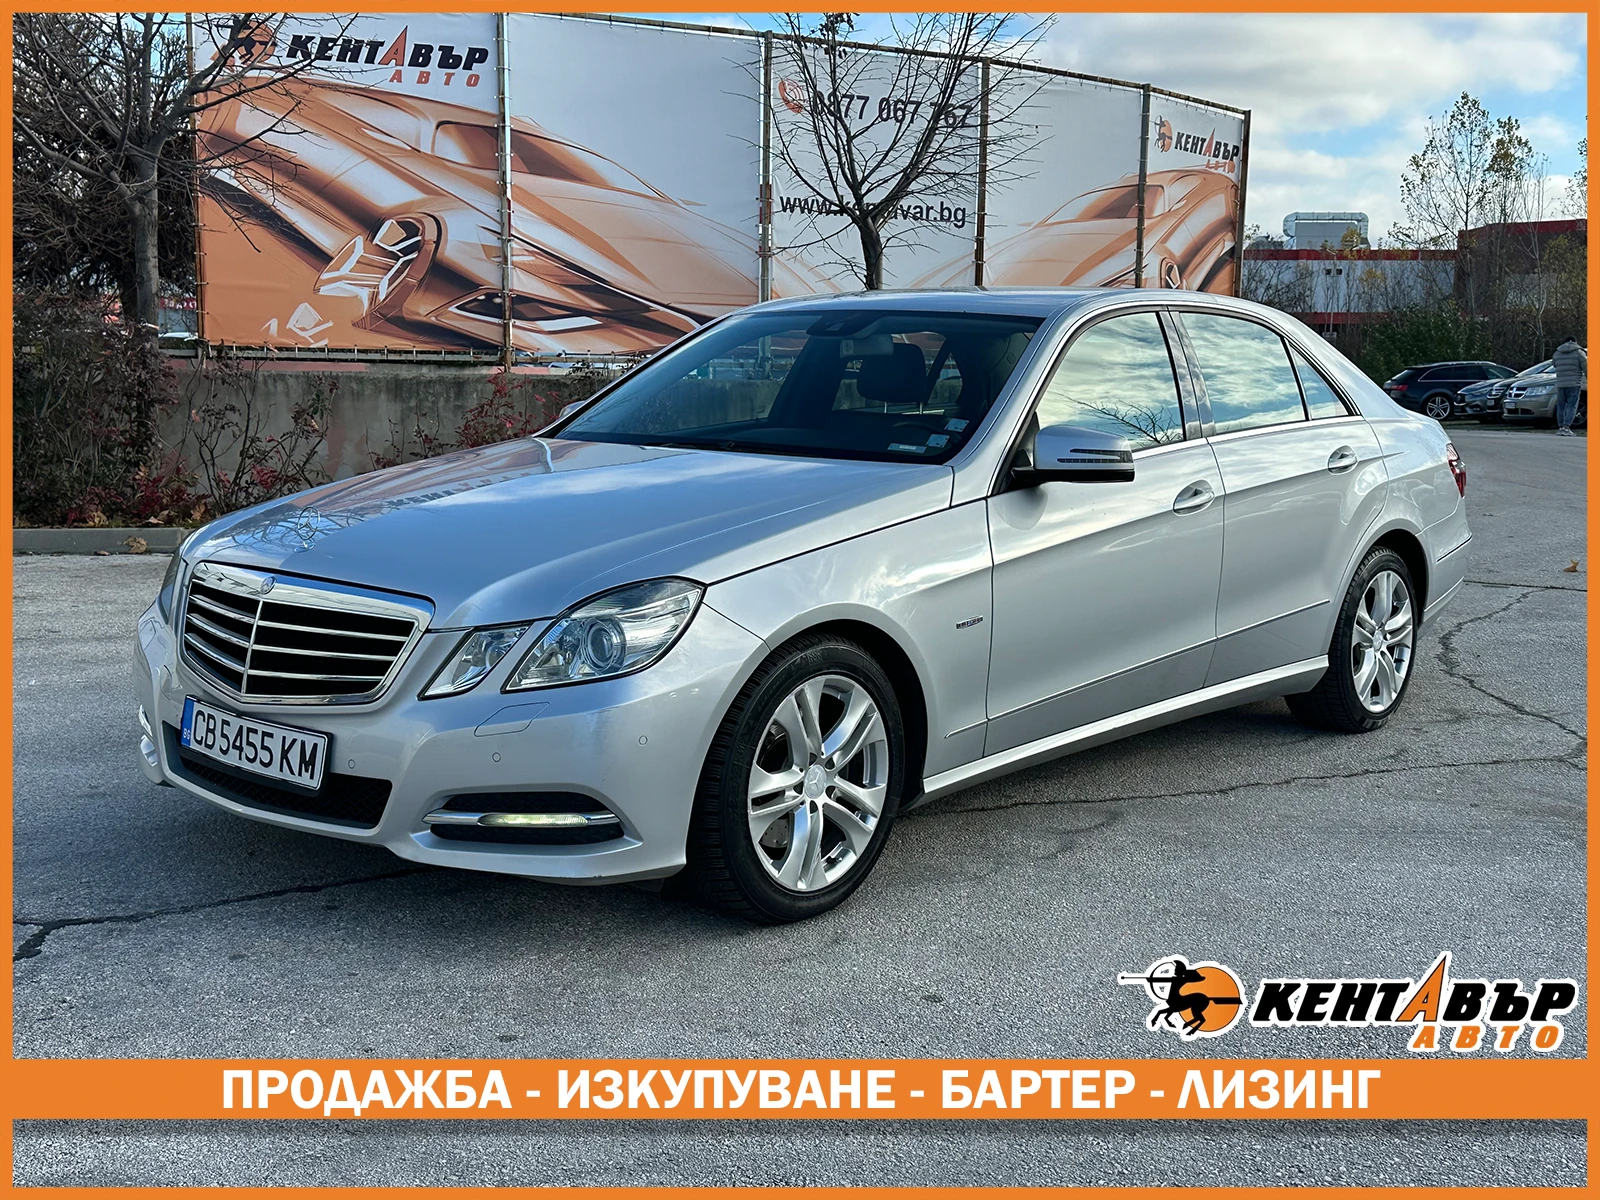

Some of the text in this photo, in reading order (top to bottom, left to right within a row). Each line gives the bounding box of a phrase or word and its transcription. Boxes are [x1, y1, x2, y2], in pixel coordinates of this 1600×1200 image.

[285, 25, 489, 71] КЕНТАВЪР
[388, 69, 481, 88] АВТО
[878, 97, 922, 125] 067
[1174, 127, 1240, 162] КЕНТАВЪР
